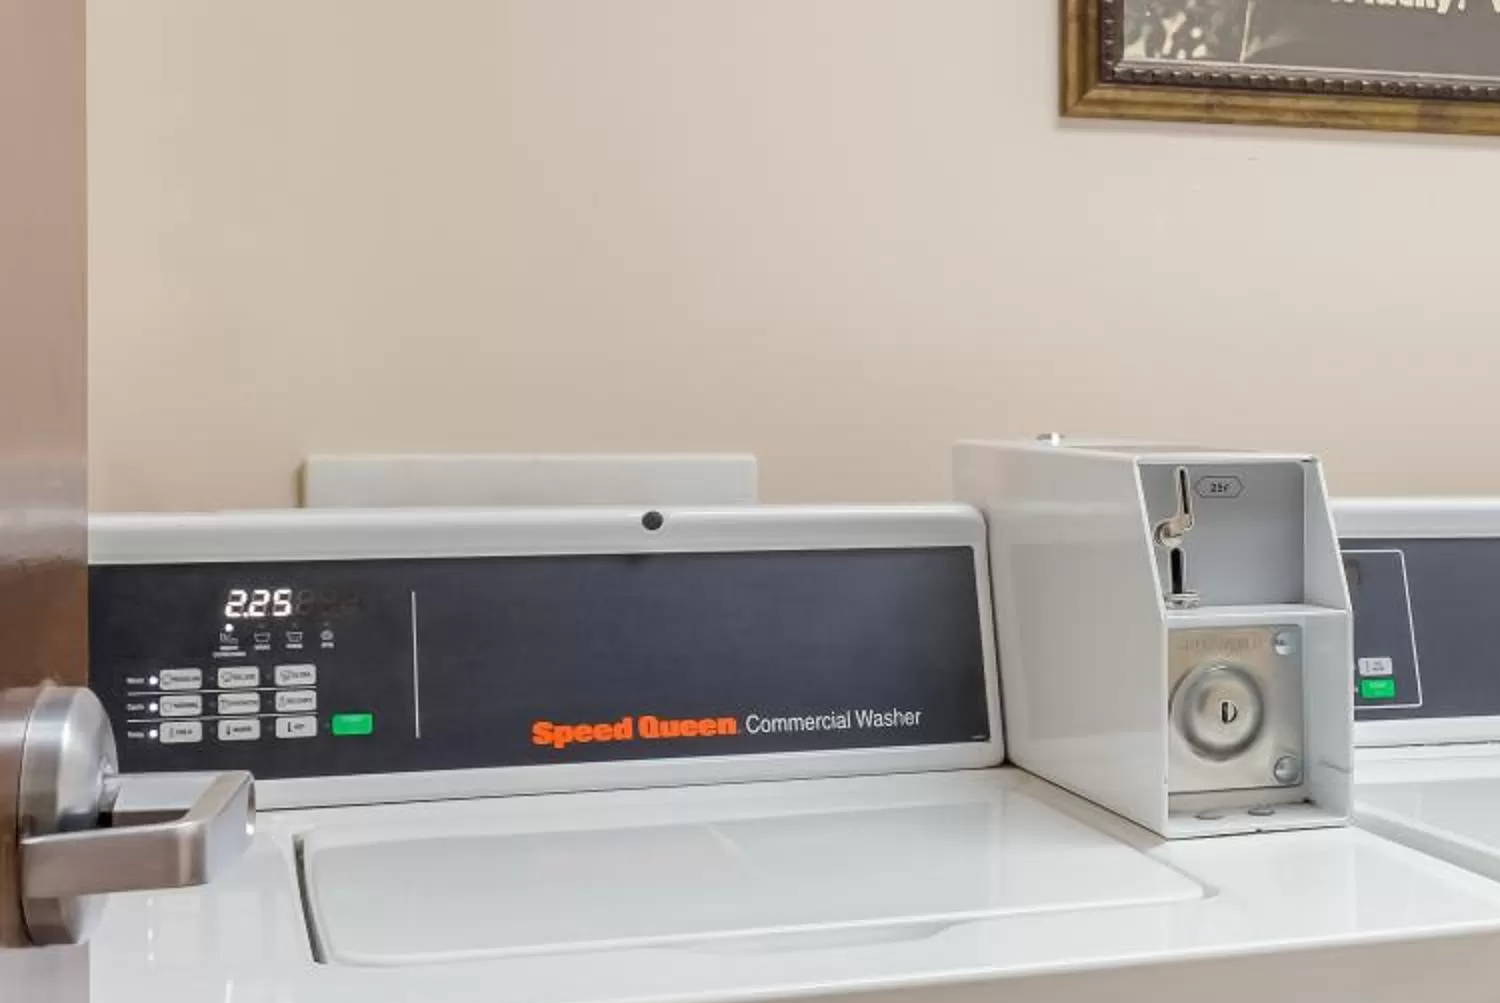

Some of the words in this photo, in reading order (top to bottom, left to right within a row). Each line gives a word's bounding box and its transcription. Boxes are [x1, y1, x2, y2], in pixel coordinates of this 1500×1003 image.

[225, 589, 293, 618] 2.25
[531, 716, 633, 749] Speed
[639, 714, 738, 740] Queen
[744, 709, 852, 735] Commercial
[855, 708, 923, 729] Washer
